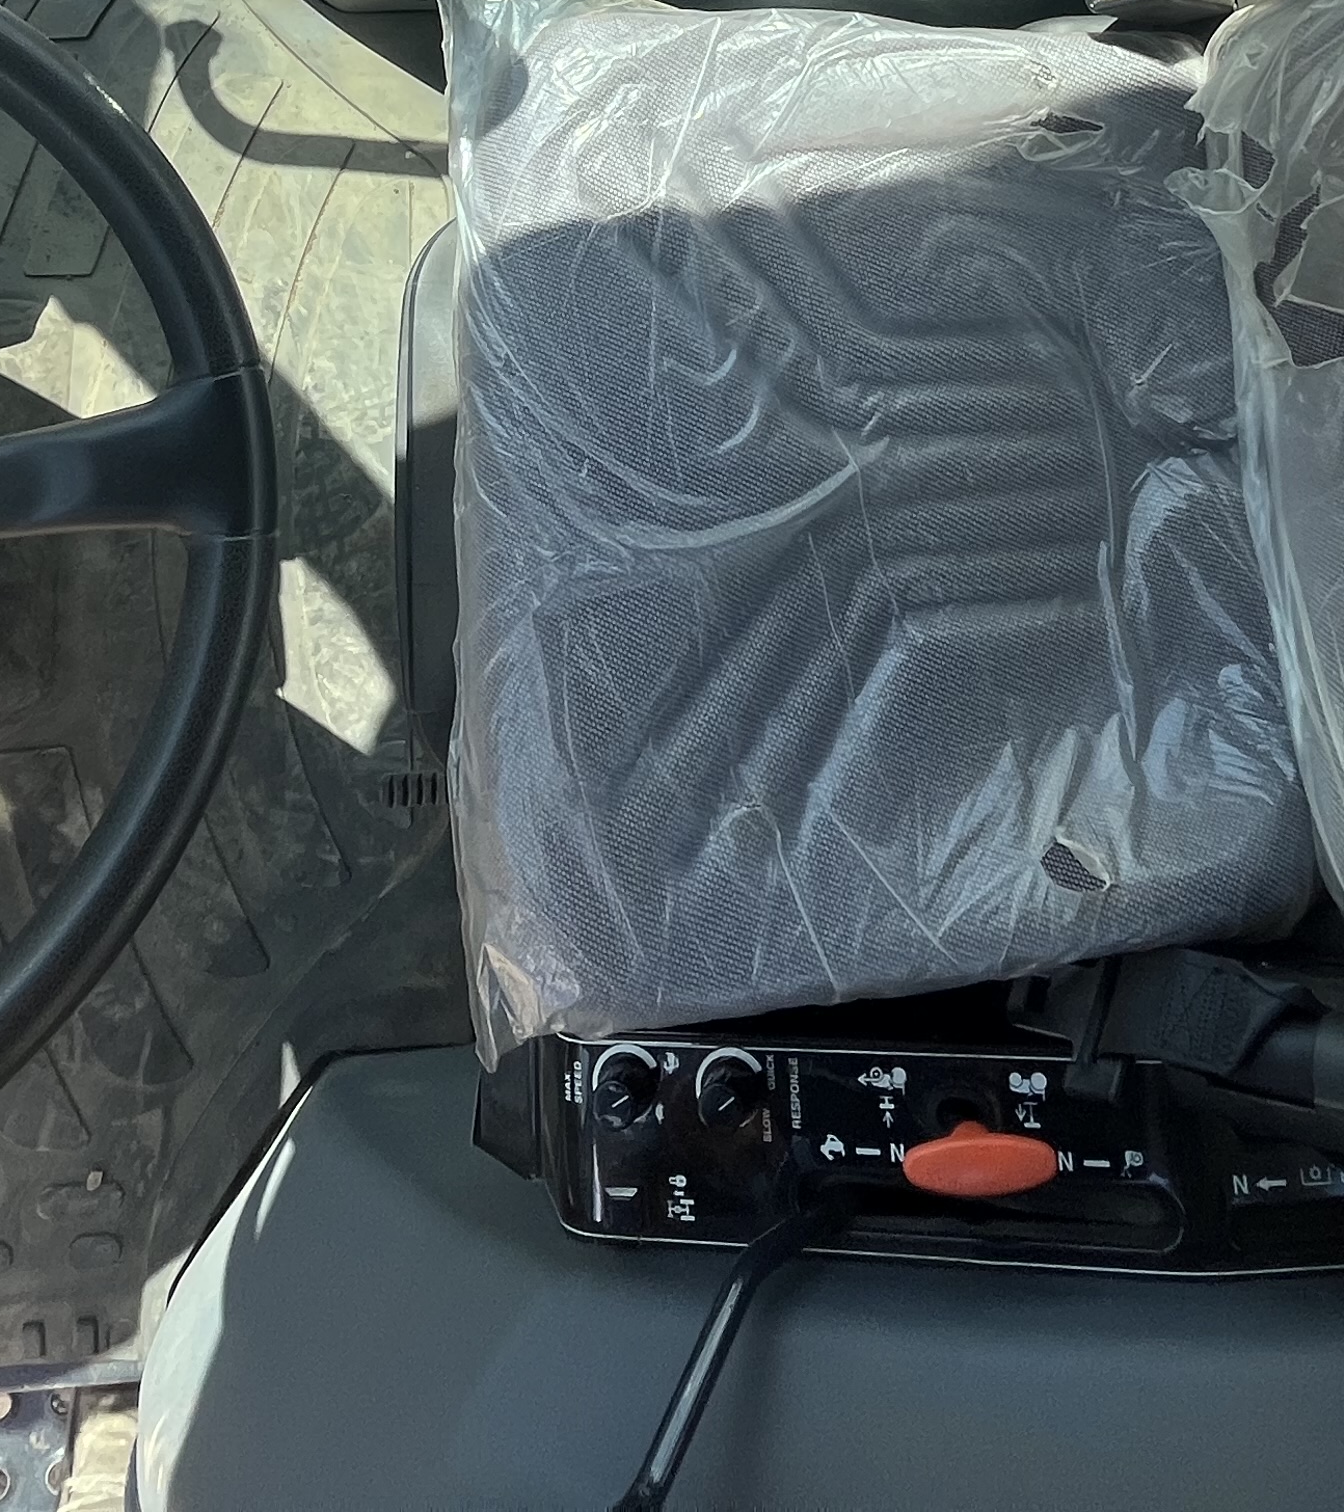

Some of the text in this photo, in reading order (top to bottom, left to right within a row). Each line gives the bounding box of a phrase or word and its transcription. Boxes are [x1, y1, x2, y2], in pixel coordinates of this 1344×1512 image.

[564, 1072, 572, 1102] MAX
[573, 1060, 583, 1104] SPEED
[787, 1057, 802, 1130] RESPONSE
[889, 1142, 905, 1164] N
[1057, 1150, 1074, 1172] N
[1231, 1173, 1249, 1196] N
